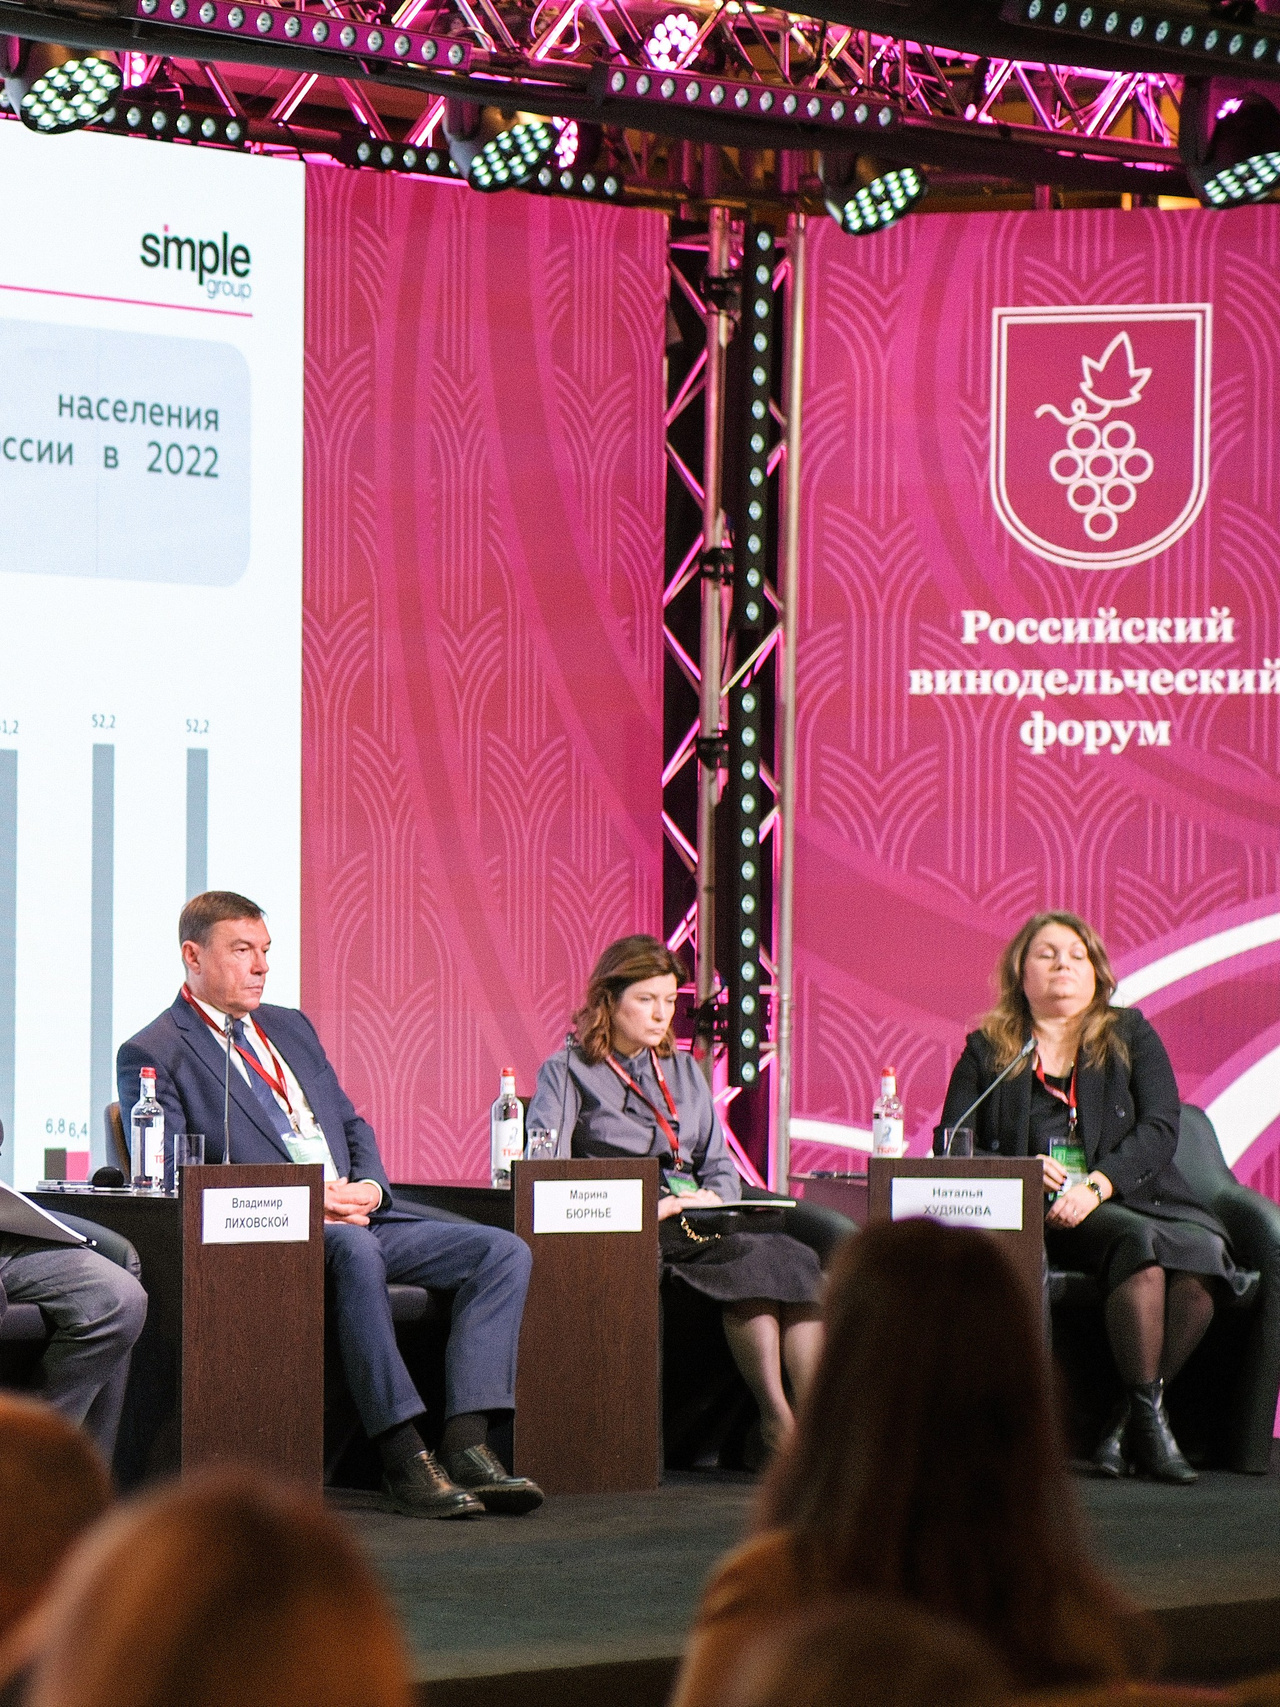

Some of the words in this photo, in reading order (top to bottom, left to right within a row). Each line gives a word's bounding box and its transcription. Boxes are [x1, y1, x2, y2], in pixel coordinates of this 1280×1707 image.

[140, 224, 251, 286] simple
[206, 279, 252, 300] group
[59, 394, 219, 431] населения
[104, 446, 119, 469] в
[147, 444, 219, 479] 2022
[961, 607, 1234, 644] Российский
[909, 658, 1280, 700] винодельческий
[91, 713, 116, 729] 52,2
[185, 718, 210, 735] 52,2
[1020, 711, 1170, 755] форум
[45, 1118, 66, 1134] 6,8
[68, 1122, 89, 1140] 6,4
[569, 1189, 609, 1203] Марина
[931, 1187, 984, 1199] Наталья
[231, 1197, 283, 1211] Владимир
[923, 1204, 992, 1217] ХУДЯКОВА
[224, 1214, 289, 1230] ЛИХОВСКОЙ
[565, 1207, 612, 1220] БЮРНЬЕ
